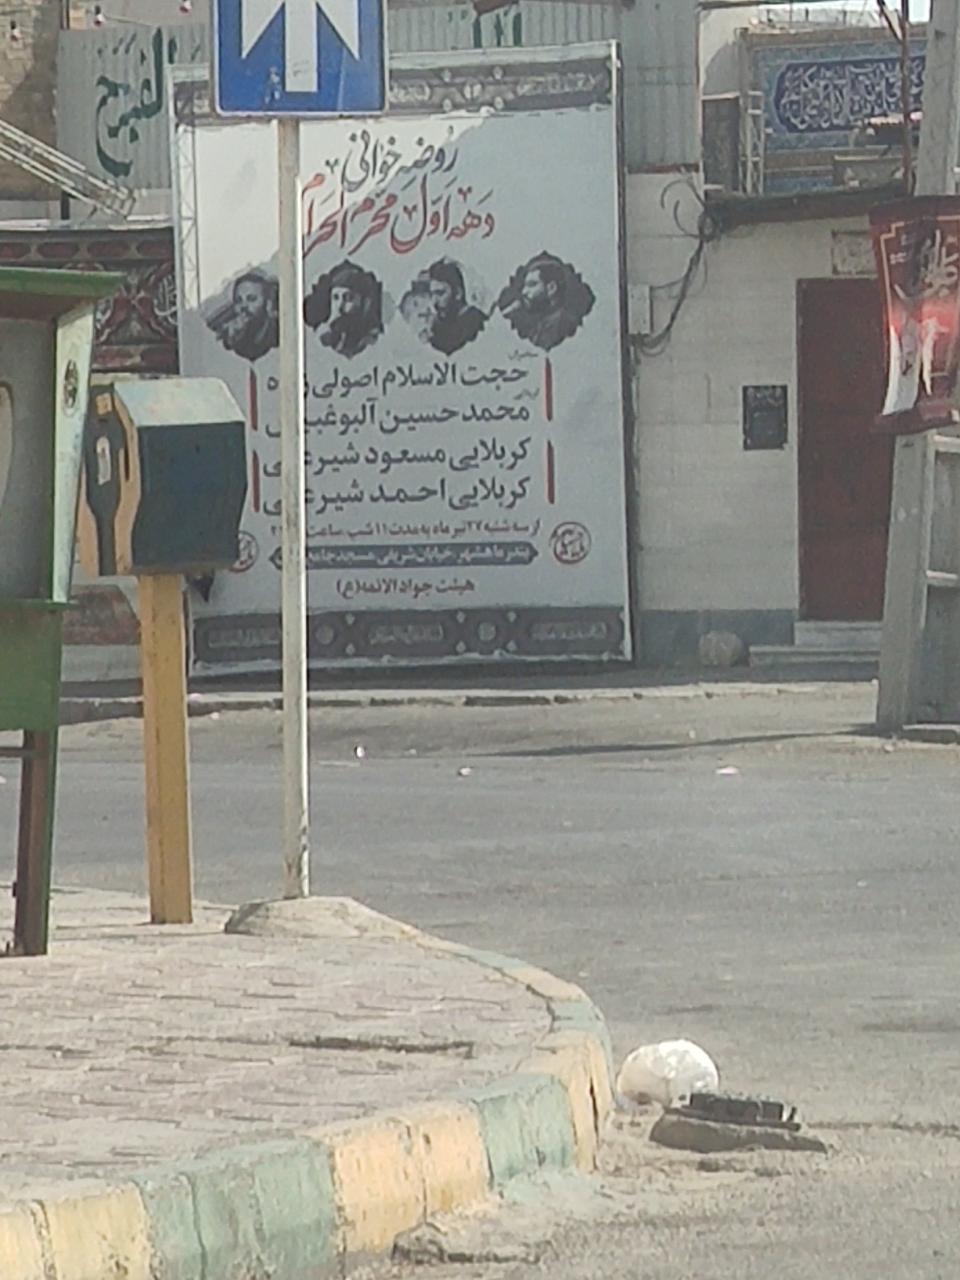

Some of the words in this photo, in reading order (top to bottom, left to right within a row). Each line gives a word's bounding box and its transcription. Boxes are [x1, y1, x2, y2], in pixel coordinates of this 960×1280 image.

[311, 366, 379, 399] اصولی
[381, 362, 457, 395] الاسلام
[460, 364, 530, 391] حجت
[379, 407, 460, 434] حسین
[461, 403, 531, 423] محمد
[364, 445, 447, 474] مسعود
[449, 437, 532, 471] کربلایی
[369, 478, 446, 503] احمد
[448, 476, 531, 510] کربلایی
